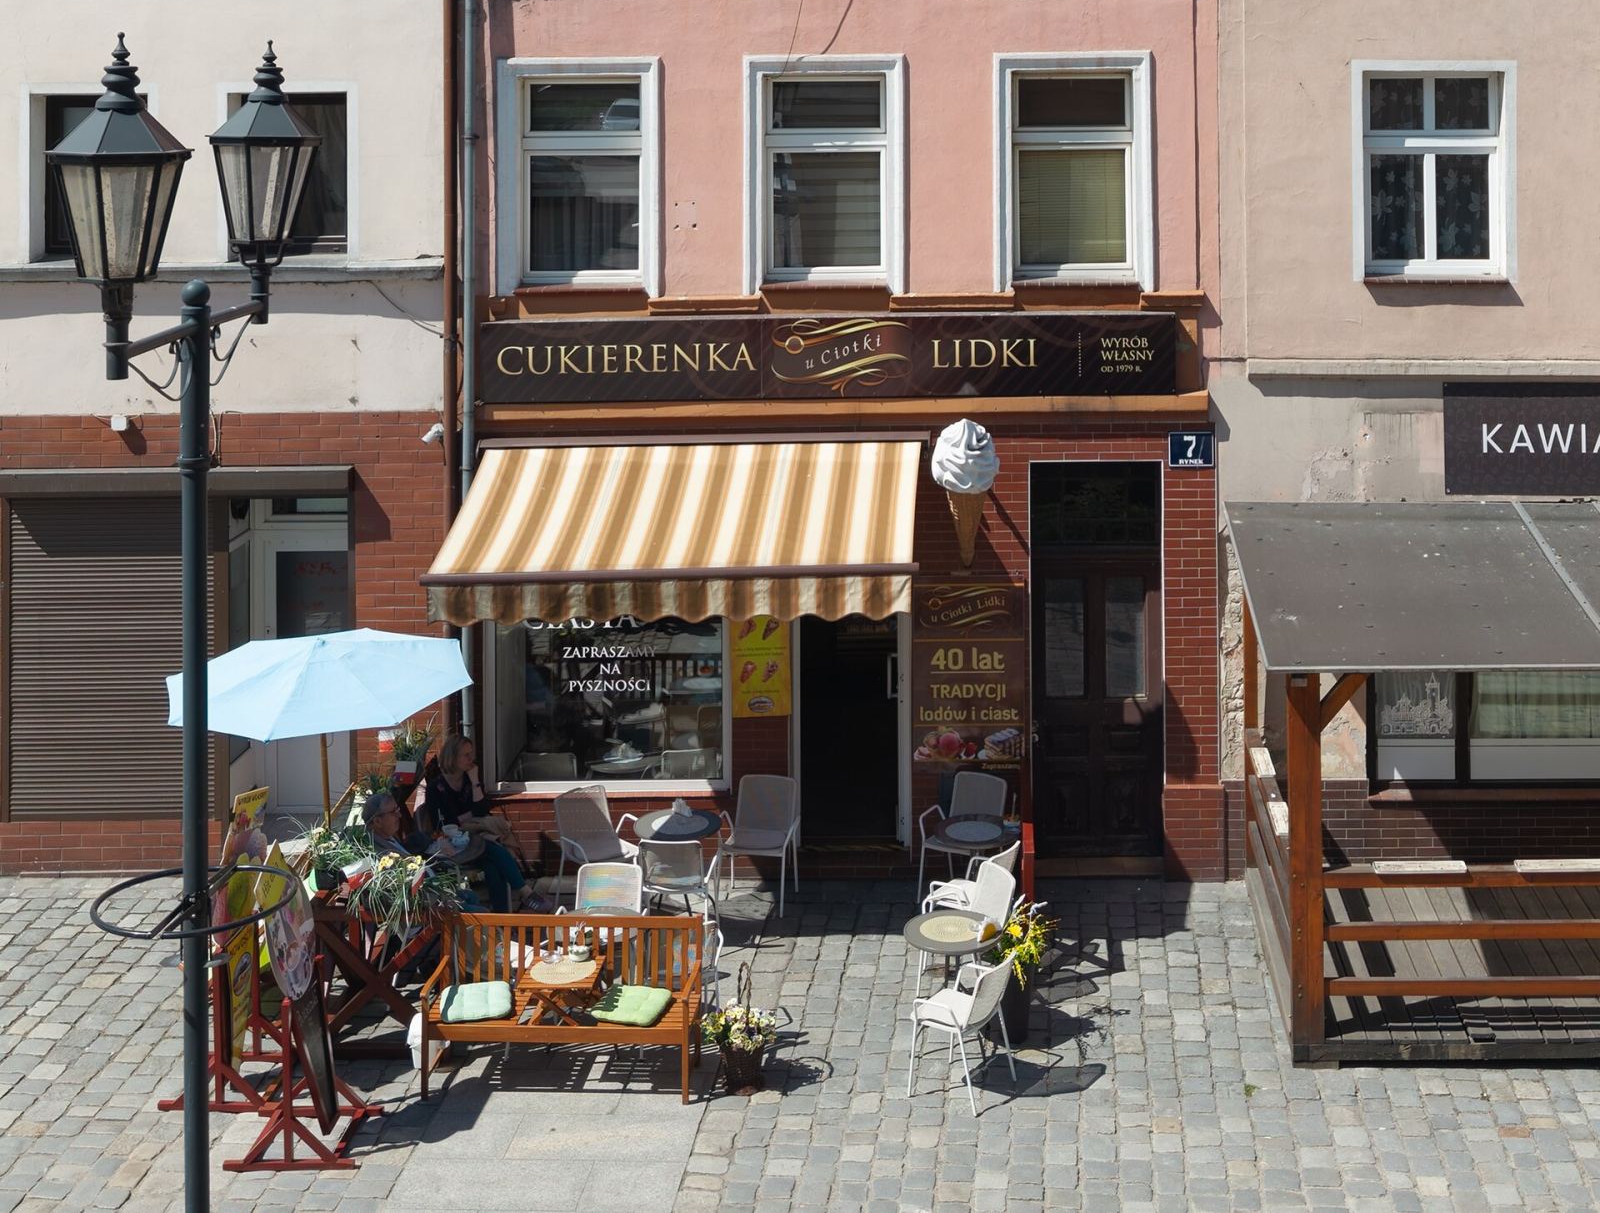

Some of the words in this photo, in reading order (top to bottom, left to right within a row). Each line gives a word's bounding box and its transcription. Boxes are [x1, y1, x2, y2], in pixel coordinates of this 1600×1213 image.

[1100, 335, 1149, 348] WYRÓB
[496, 342, 758, 375] CUKIERENKA
[805, 358, 814, 369] u
[820, 333, 882, 365] Ciotki
[931, 338, 1038, 368] LIDKI
[1100, 350, 1155, 361] WŁASNY
[1100, 365, 1113, 373] OD
[1116, 364, 1133, 373] 1979
[1183, 435, 1196, 457] 7
[1482, 423, 1600, 454] KAWI
[931, 614, 938, 623] u
[941, 601, 972, 621] Ciotki
[976, 595, 1006, 610] Lidki
[562, 646, 657, 659] ZAPRASZAMY
[930, 648, 964, 670] 40
[971, 647, 1005, 670] lat
[600, 663, 621, 675] NA
[568, 676, 650, 692] PYSZNOŚCI
[930, 684, 1006, 700] TRADYCJI
[919, 705, 967, 721] lodów
[971, 706, 976, 721] i
[980, 708, 1019, 721] ciast
